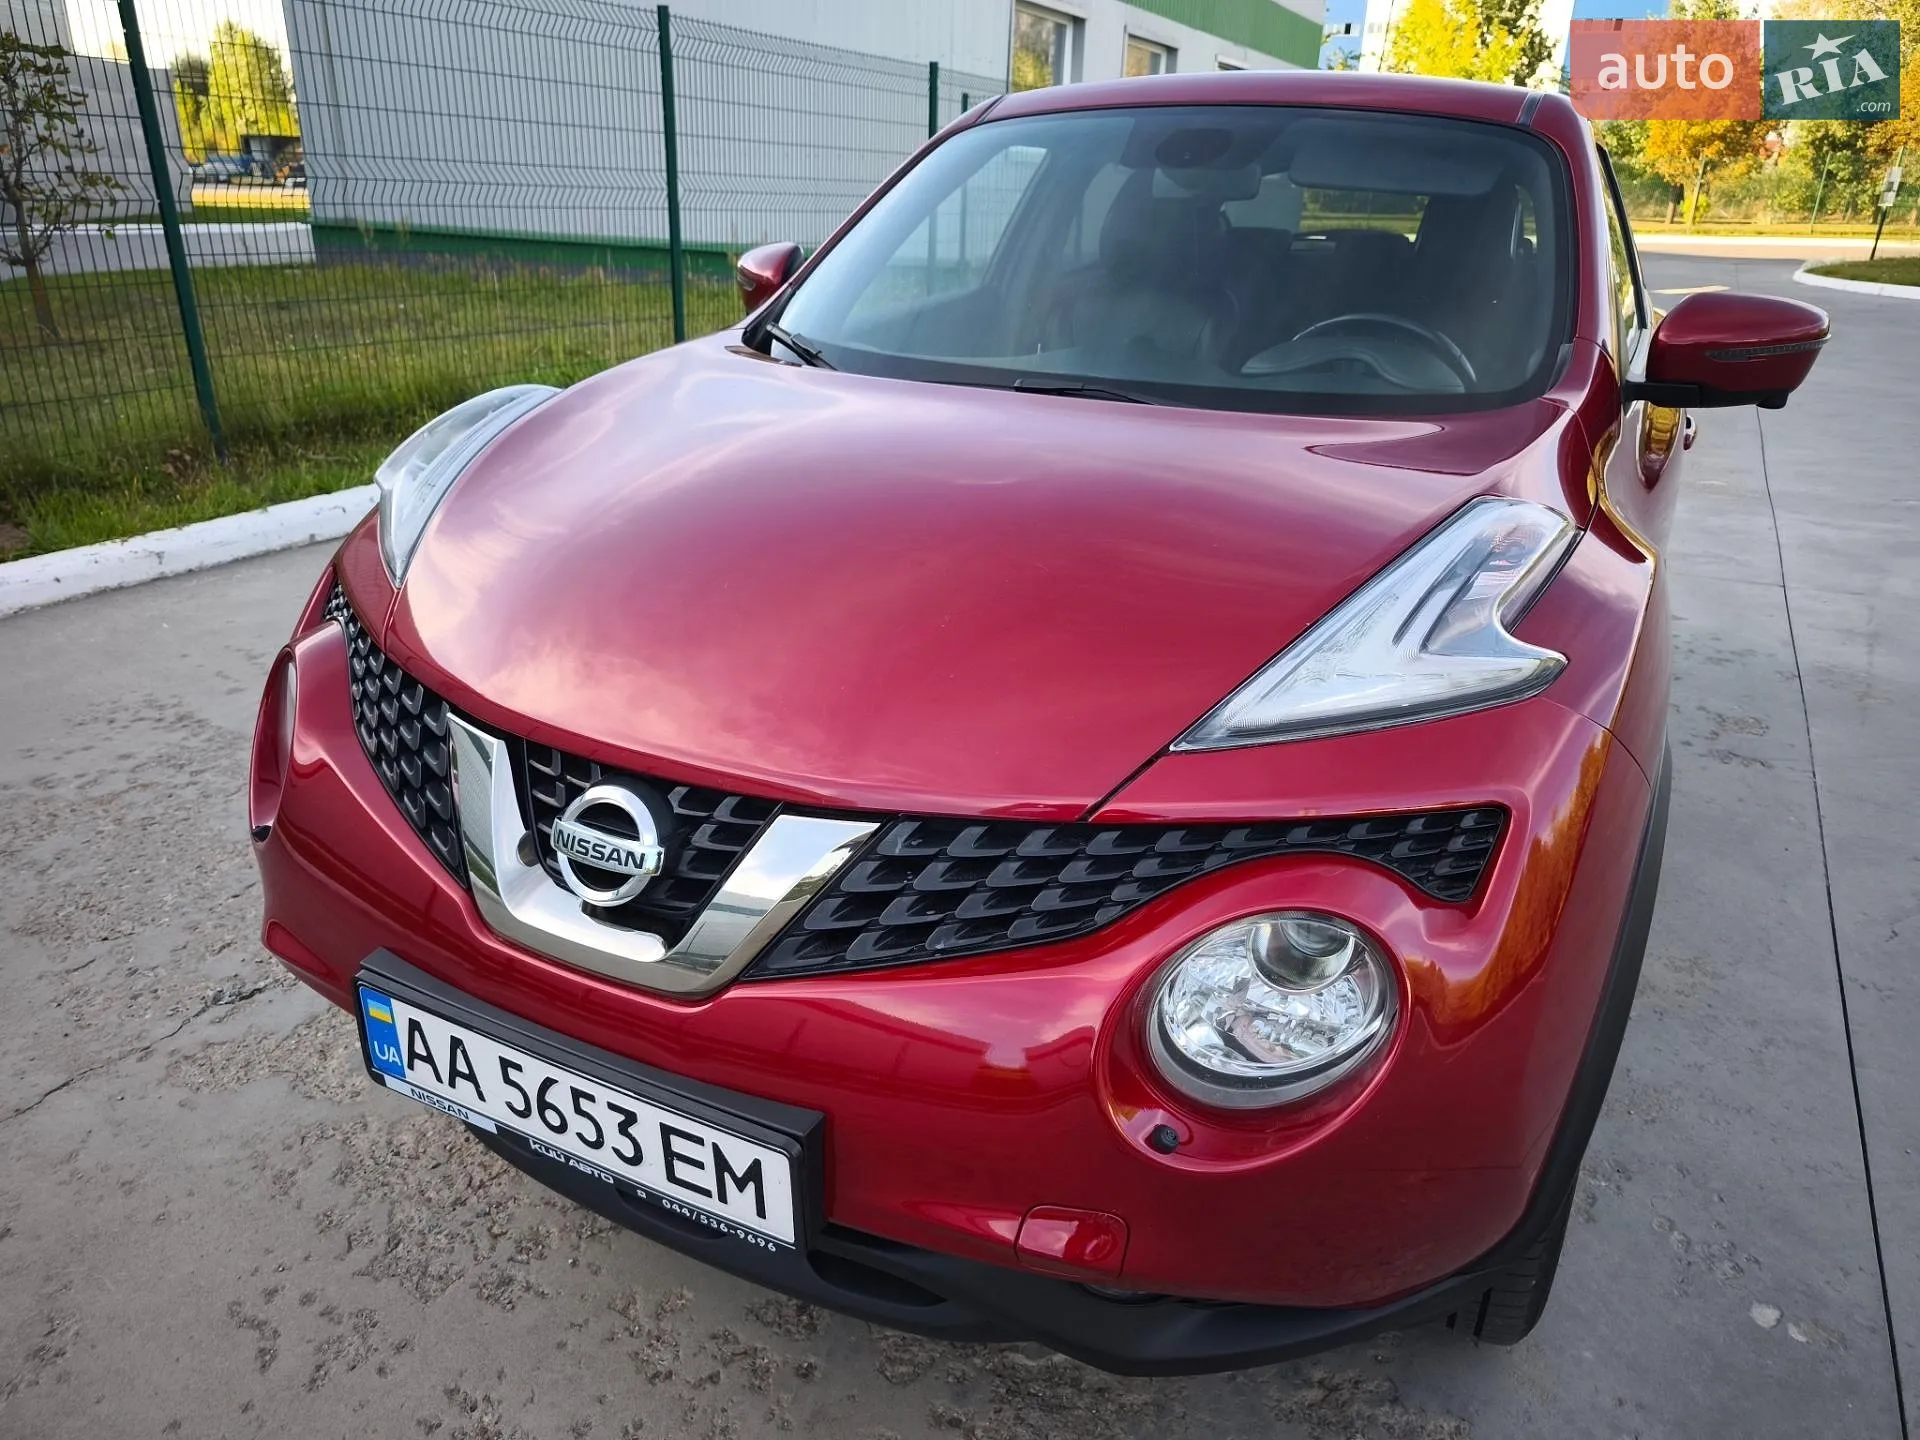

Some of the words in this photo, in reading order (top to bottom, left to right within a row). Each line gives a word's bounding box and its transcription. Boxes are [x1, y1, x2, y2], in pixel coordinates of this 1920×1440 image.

[555, 828, 646, 870] NISSAN
[374, 1041, 402, 1066] UA
[407, 1016, 487, 1103] AA
[498, 1055, 644, 1167] 5653
[659, 1121, 767, 1220] EM
[410, 1087, 470, 1120] NISSAN
[661, 1199, 777, 1252] 044/536-9696
